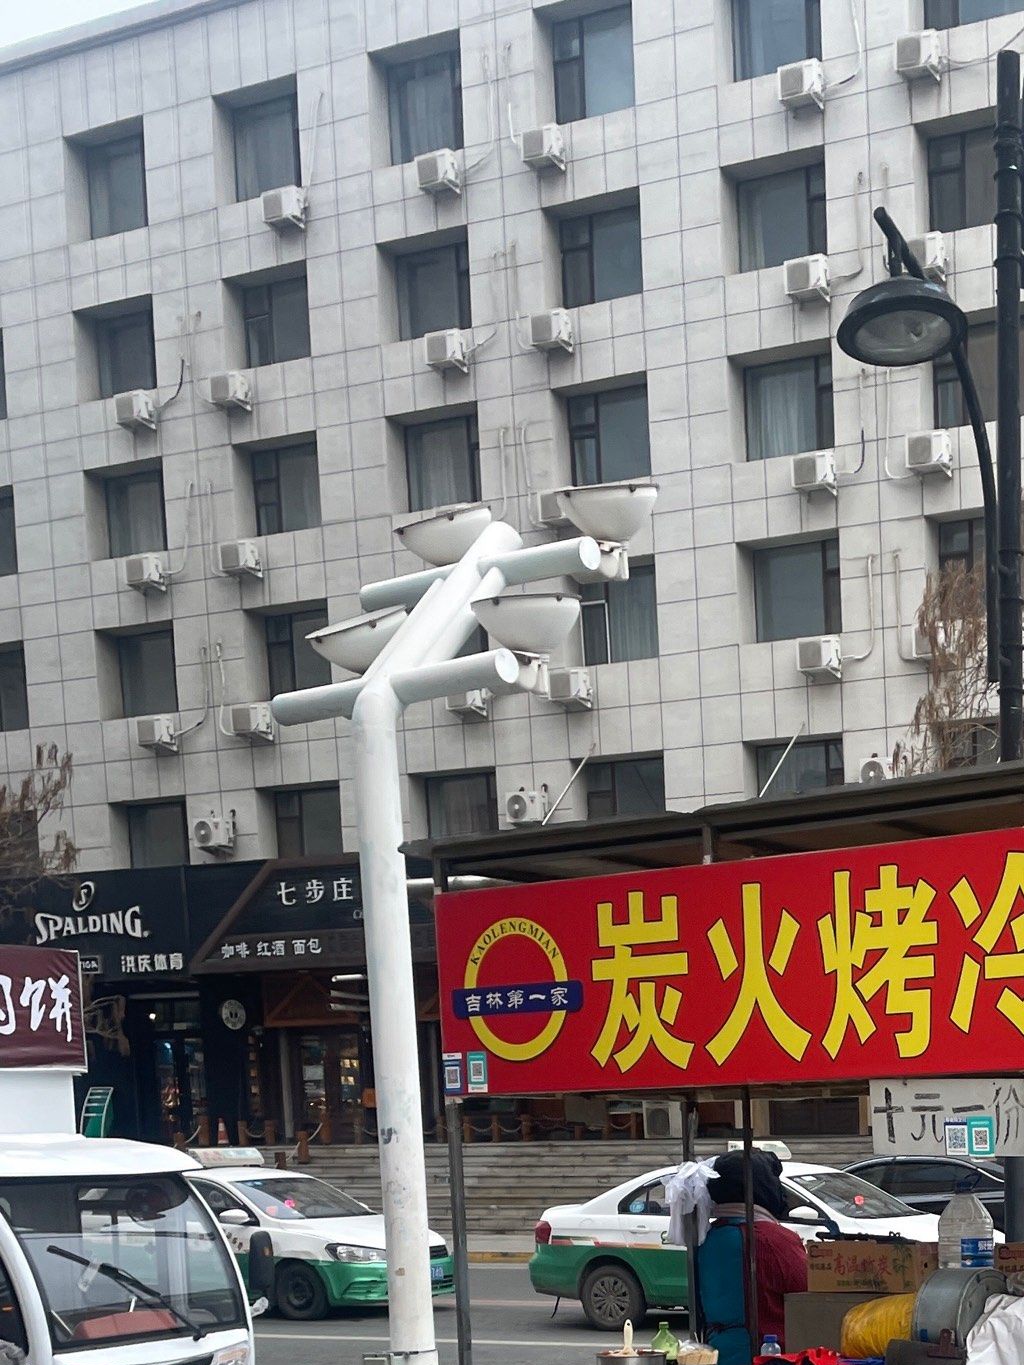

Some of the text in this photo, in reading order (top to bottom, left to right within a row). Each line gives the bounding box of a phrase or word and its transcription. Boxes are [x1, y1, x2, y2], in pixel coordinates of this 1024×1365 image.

[277, 877, 353, 906] 七步庄
[35, 905, 142, 945] SPALDING
[221, 938, 322, 960] 咖啡 红酒 面包
[470, 920, 560, 966] KAOLENGMIAN
[121, 953, 184, 973] 洪庆体育
[465, 986, 569, 1013] 吉林第一家
